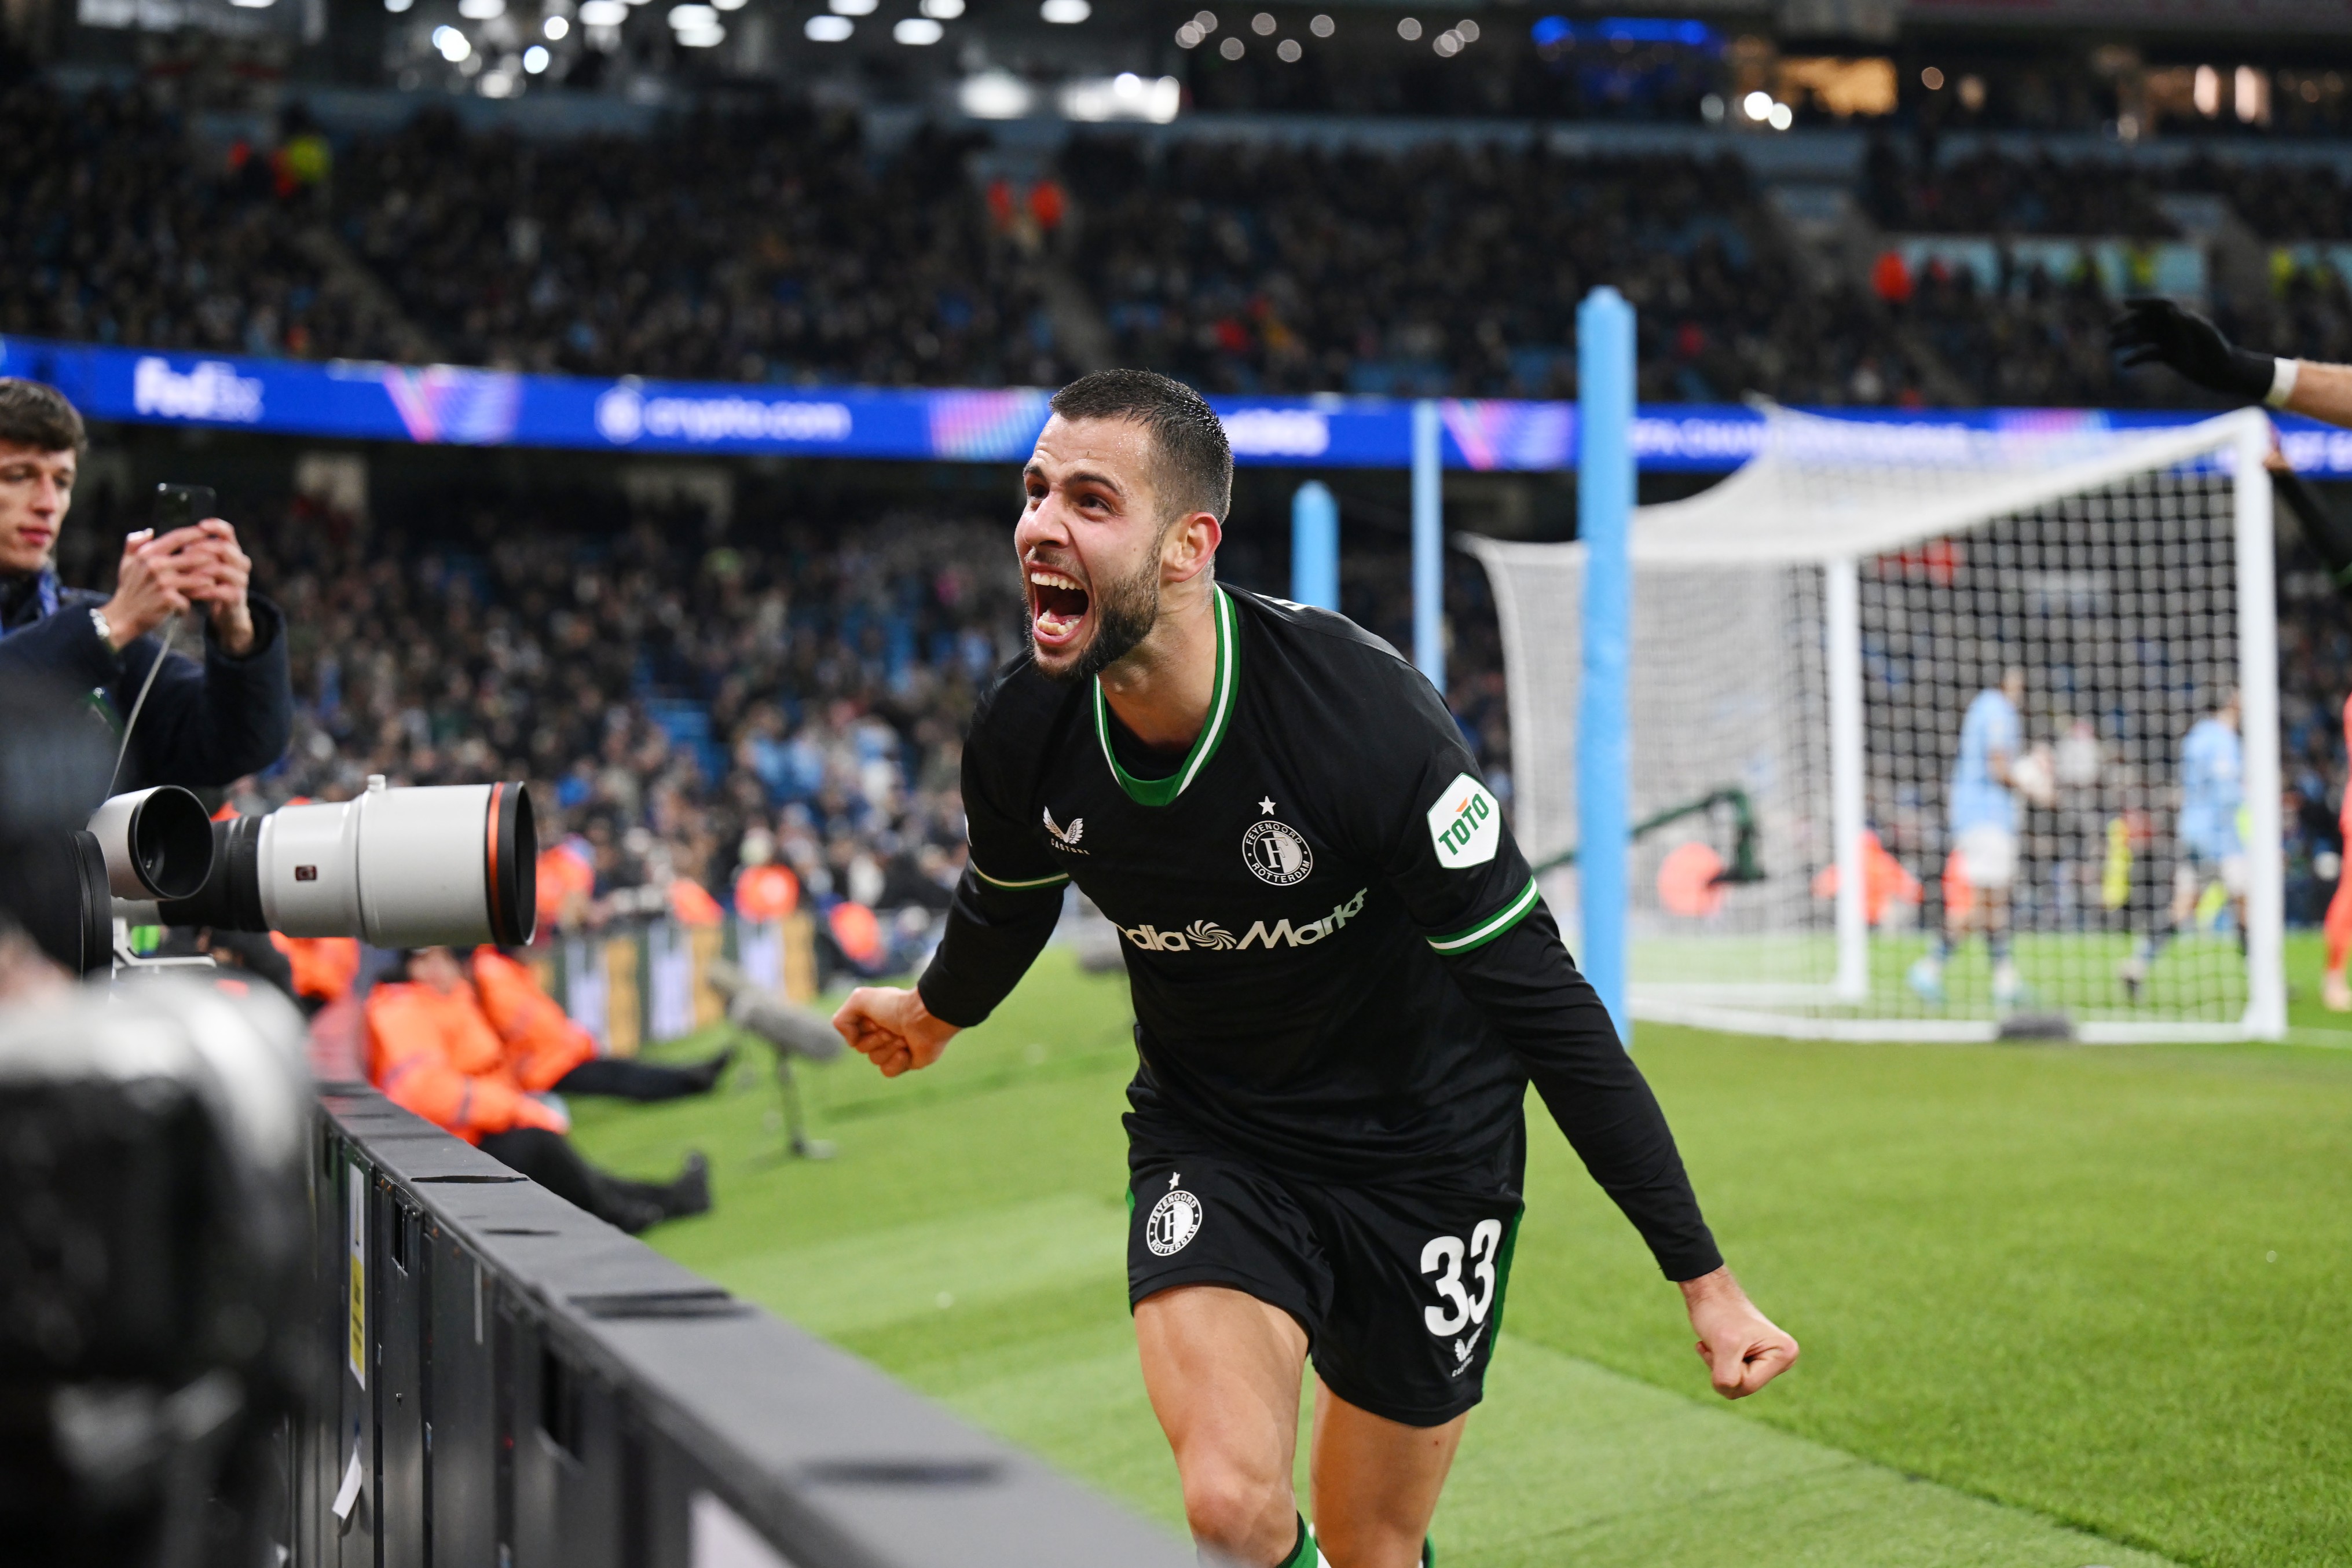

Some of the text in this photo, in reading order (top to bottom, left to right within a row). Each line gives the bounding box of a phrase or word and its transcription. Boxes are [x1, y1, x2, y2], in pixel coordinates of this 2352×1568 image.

[1245, 823, 1302, 845] FEYENOORD
[1438, 793, 1489, 855] TOTO
[1050, 838, 1090, 855] CASTORE
[1251, 860, 1310, 883] ROTTERDAM
[1236, 887, 1368, 950] Markt
[1150, 1193, 1197, 1223] FEYENOORD
[1151, 1224, 1197, 1254] ROTTERDAM
[1420, 1219, 1502, 1336] 33
